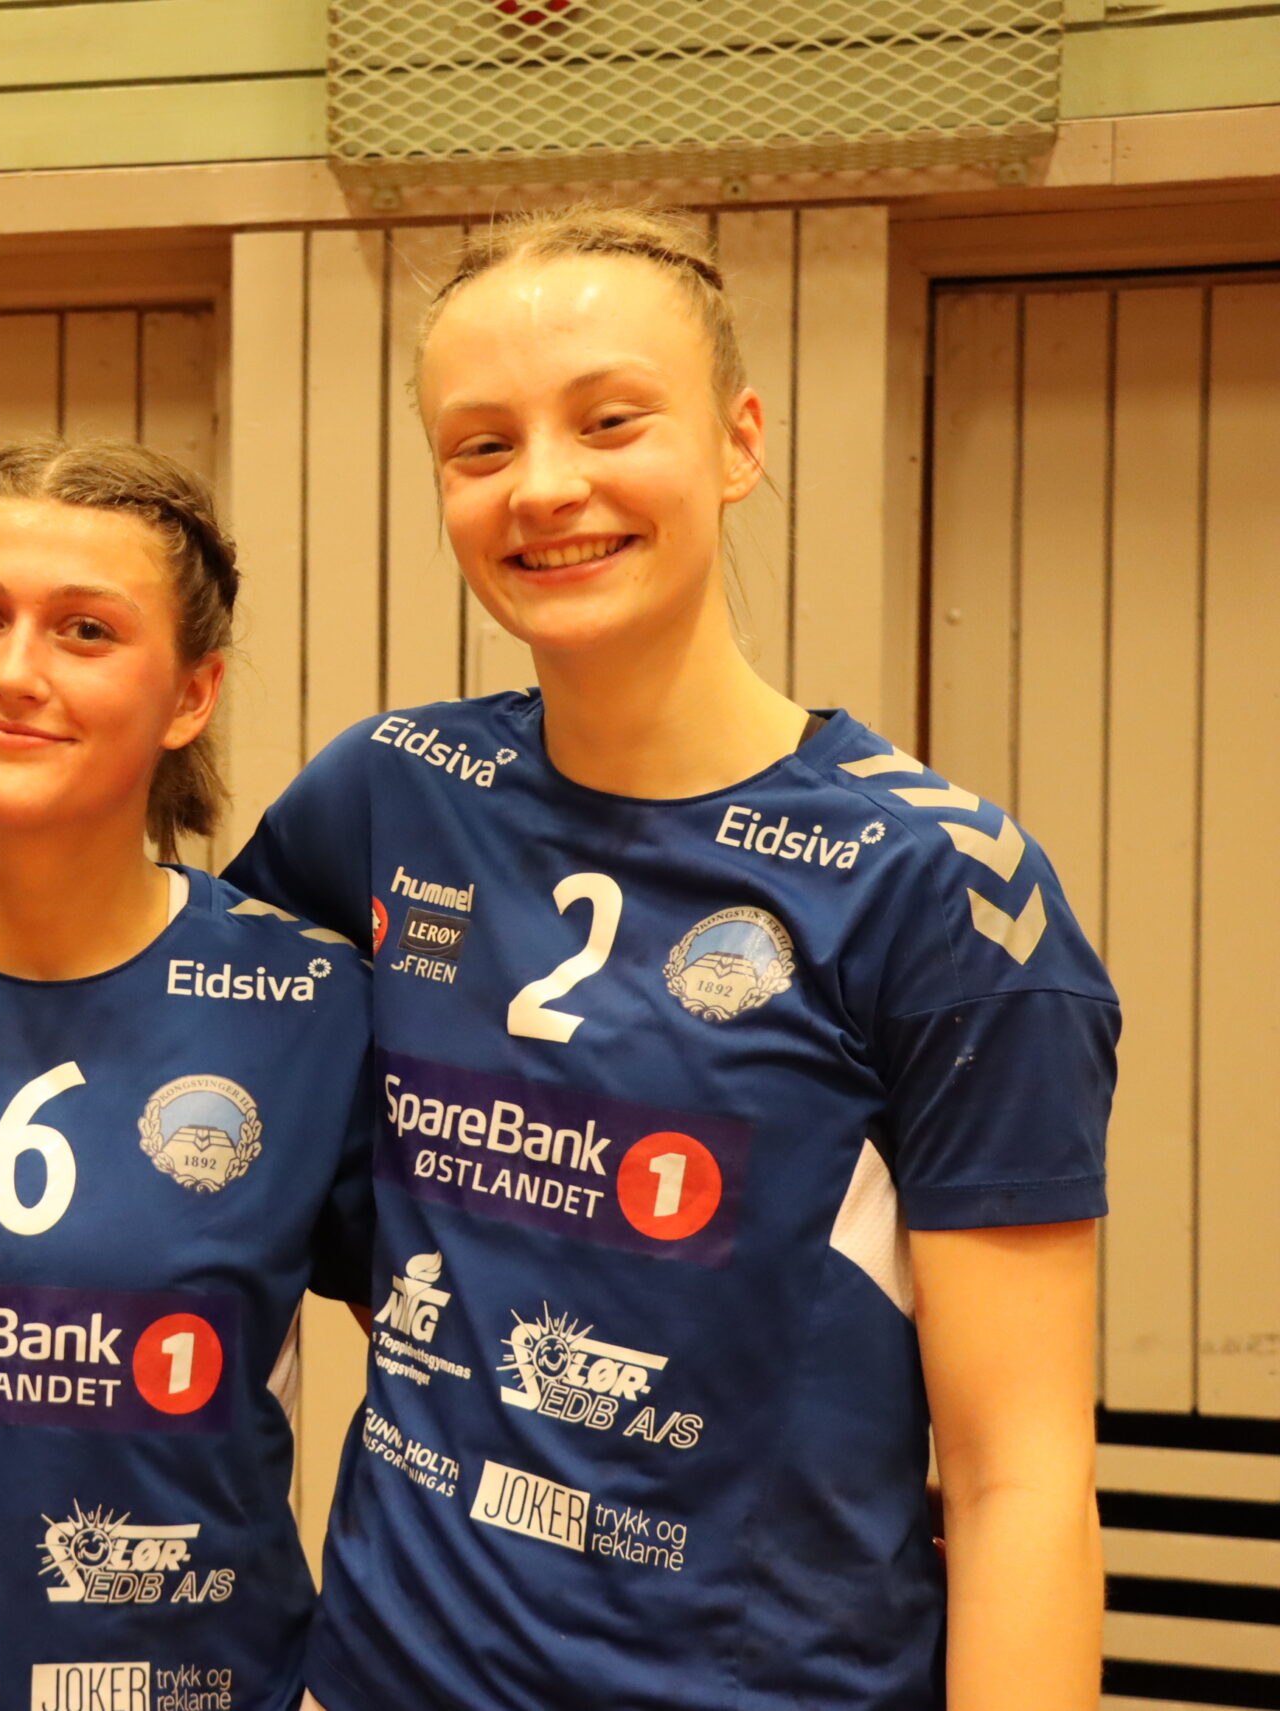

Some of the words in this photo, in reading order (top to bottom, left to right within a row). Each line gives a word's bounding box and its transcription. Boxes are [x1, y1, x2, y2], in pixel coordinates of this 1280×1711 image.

[371, 716, 497, 788] Eidsiva
[715, 805, 861, 869] Eidsiva
[390, 866, 474, 912] hummel
[407, 920, 461, 945] LERØY
[167, 959, 315, 1002] Eidsiva
[507, 872, 622, 1043] 2
[697, 980, 734, 998] 1892
[160, 1079, 240, 1102] KONGSVINGER
[184, 1155, 217, 1170] 1892
[385, 1074, 611, 1176] SpareBank
[649, 1152, 687, 1217] 1
[414, 1149, 604, 1218] ØSTLANDET
[161, 1332, 195, 1394] 1
[537, 1384, 619, 1430] EDB
[623, 1406, 704, 1449] A/S
[404, 1439, 460, 1481] HOLTH
[484, 1472, 585, 1546] JOKER
[595, 1503, 649, 1536] trykk
[656, 1520, 688, 1550] og
[591, 1531, 684, 1571] reklame
[83, 1570, 165, 1603] EDB
[171, 1568, 235, 1603] A/S
[42, 1667, 147, 1711] JOKER
[156, 1664, 201, 1693] trykk
[206, 1668, 231, 1691] og
[156, 1688, 231, 1711] reklame
